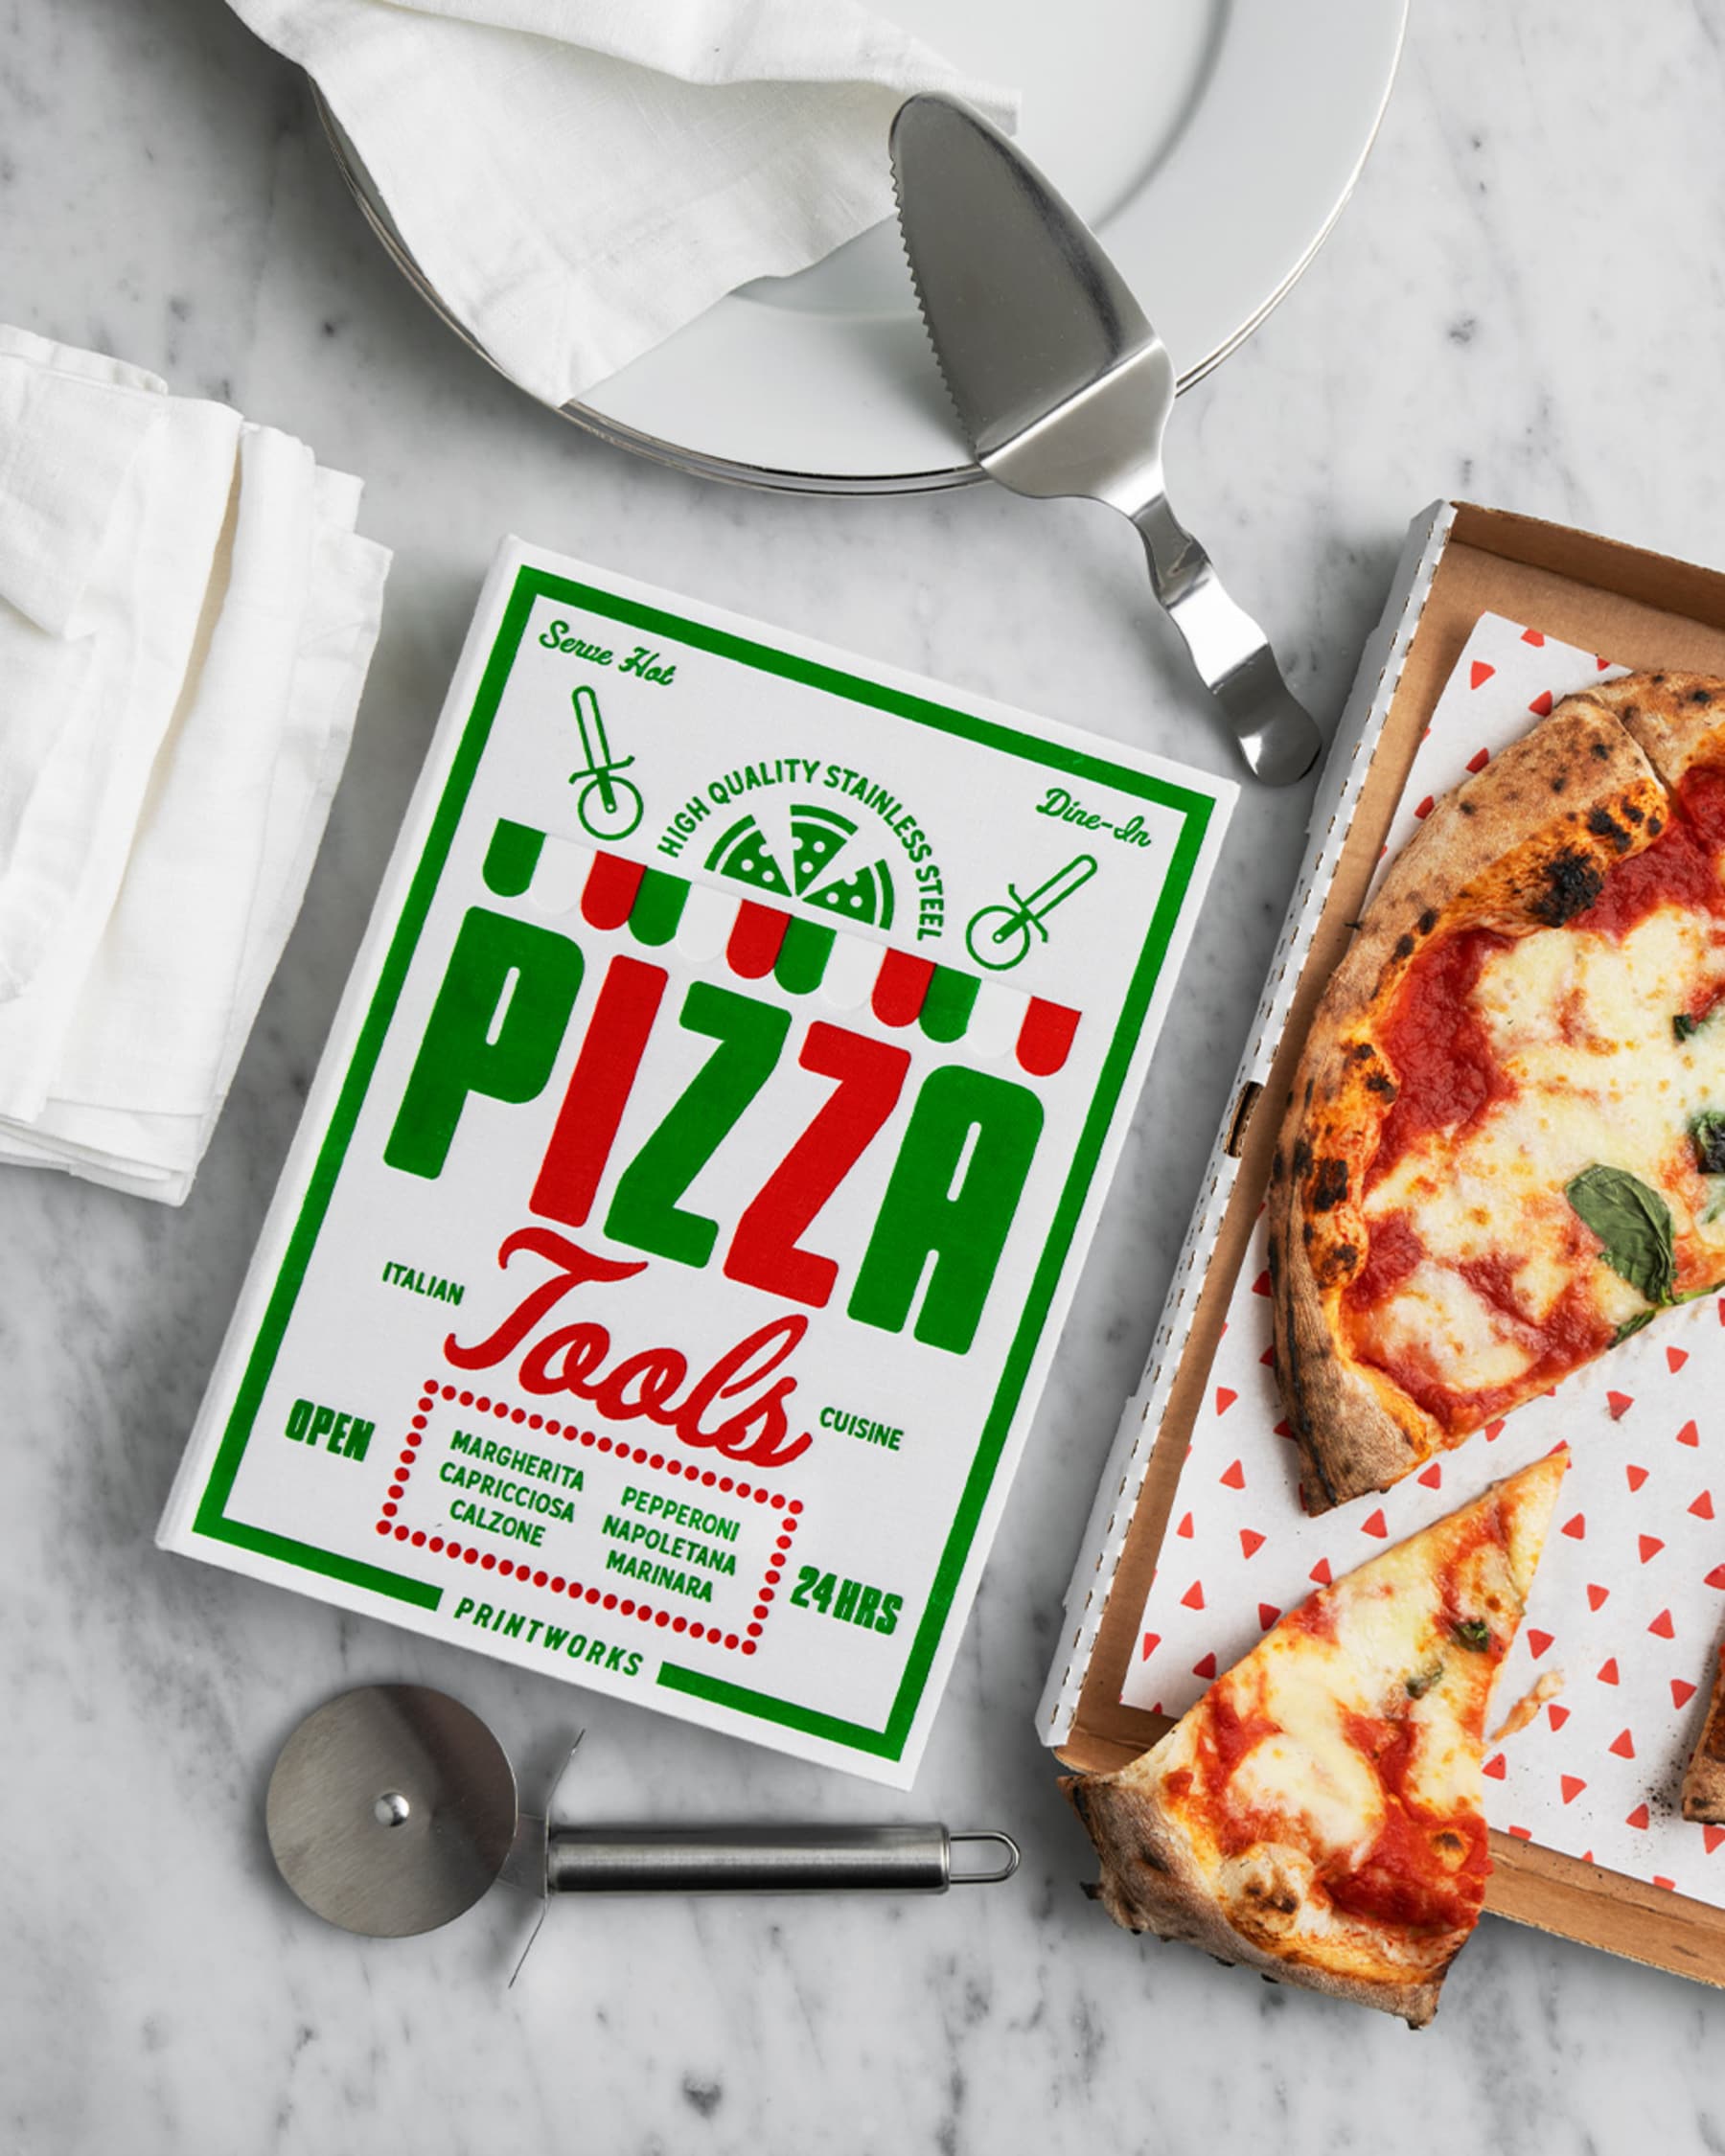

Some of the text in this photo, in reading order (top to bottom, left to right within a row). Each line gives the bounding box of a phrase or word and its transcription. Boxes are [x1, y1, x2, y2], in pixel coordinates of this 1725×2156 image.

[539, 620, 675, 686] Serve Hot
[1036, 788, 1150, 847] Dine-In
[656, 758, 944, 941] HIGH QUALITY STAINLESS STEEL
[383, 906, 1044, 1355] PIZZA
[382, 1263, 464, 1305] ITALIAN
[444, 1227, 813, 1467] Tools
[285, 1399, 375, 1461] OPEN
[819, 1407, 903, 1451] CUISINE
[450, 1431, 583, 1491] MARGHERITA
[439, 1462, 574, 1523] CAPRICCIOSA
[621, 1487, 740, 1542] PEPPERONI
[449, 1500, 545, 1547] CALZONE
[602, 1514, 735, 1576] NAPOLETANA
[606, 1550, 712, 1603] MARINARA
[453, 1598, 643, 1676] PRINTWORKS
